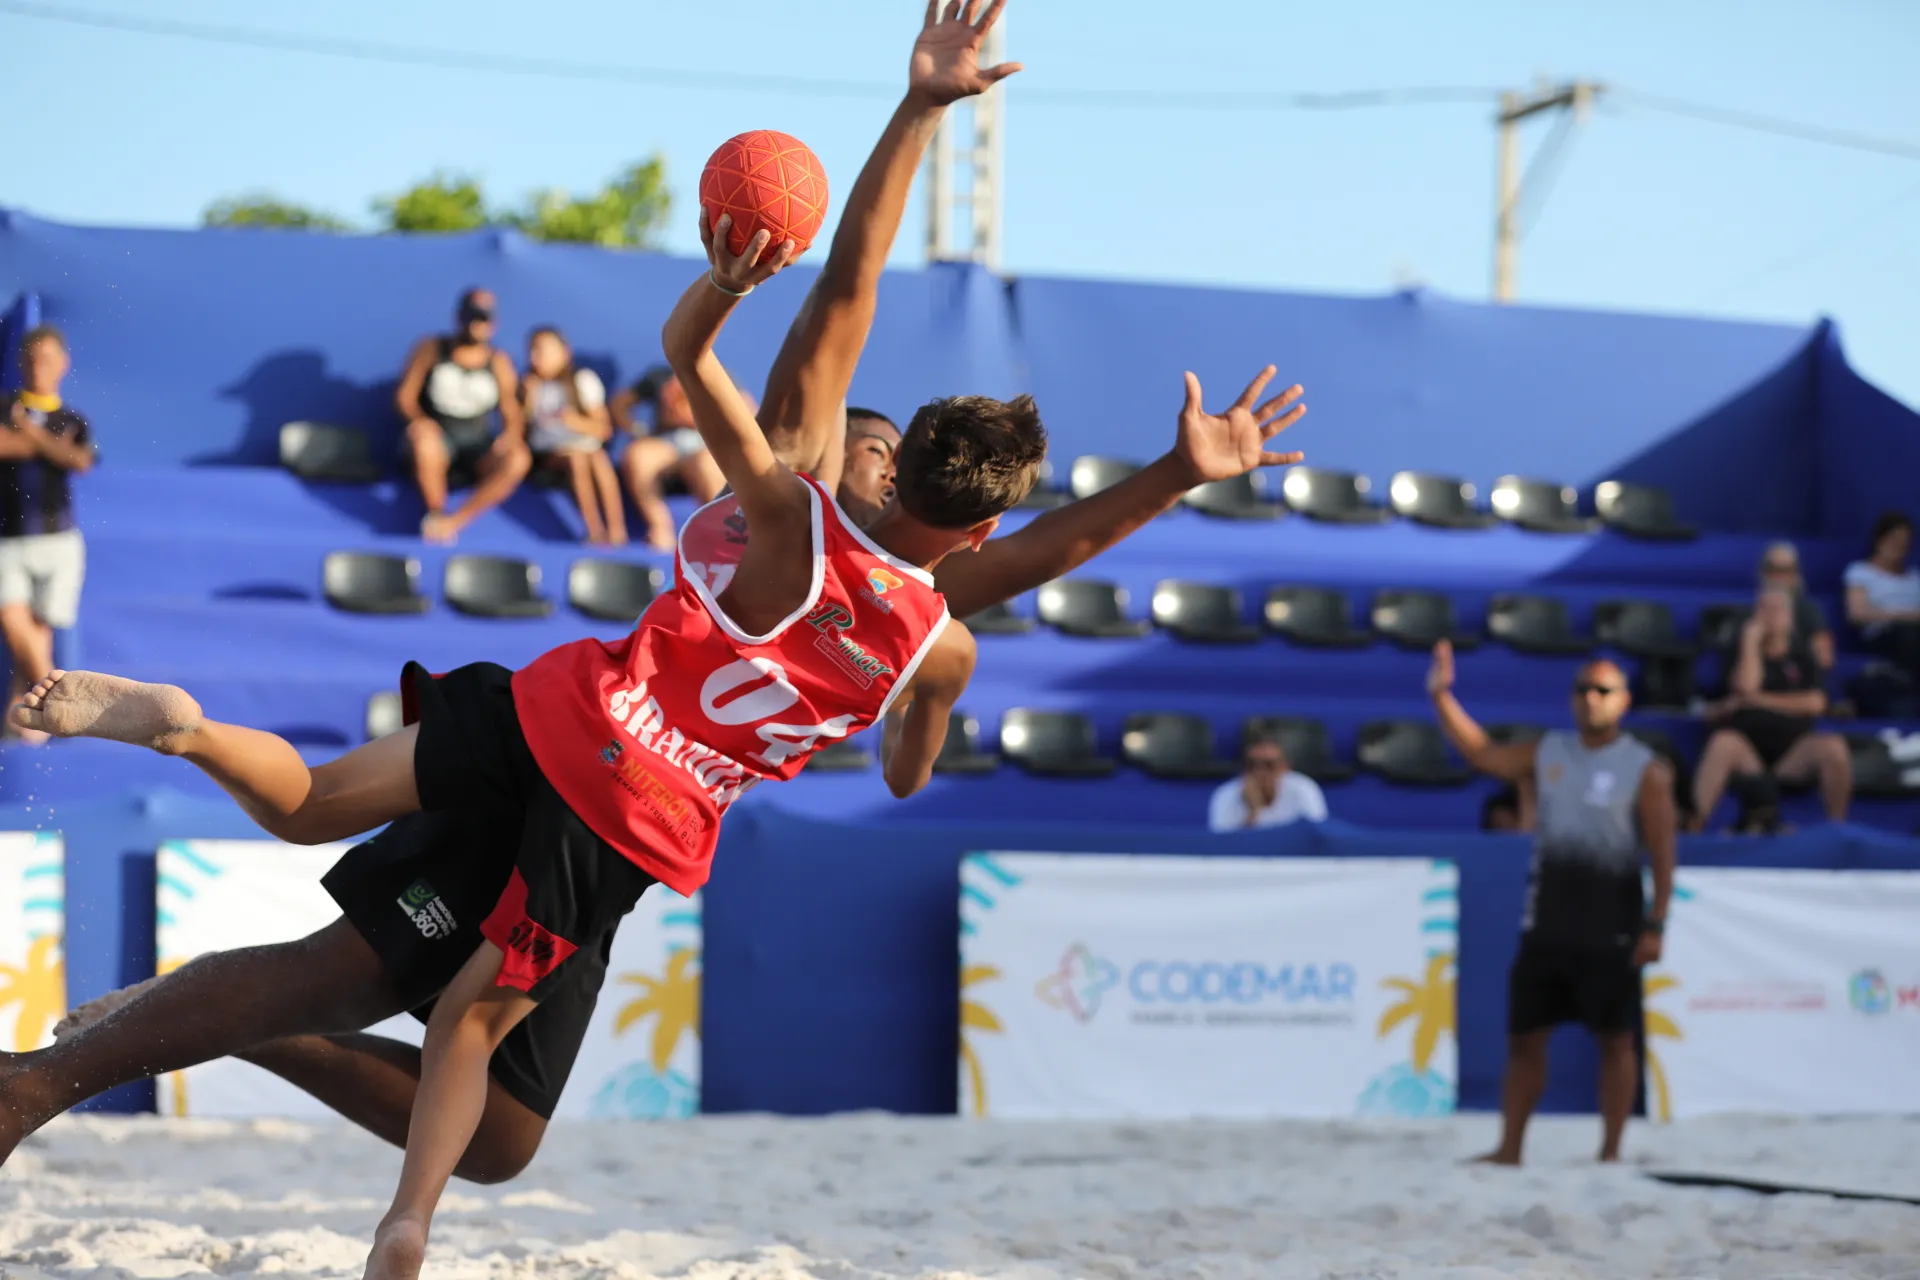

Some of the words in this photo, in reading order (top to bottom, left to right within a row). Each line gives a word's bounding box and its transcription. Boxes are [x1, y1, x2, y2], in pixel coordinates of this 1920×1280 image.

[805, 602, 893, 678] Pomar
[700, 657, 858, 768] 04
[611, 771, 643, 802] SEMPRE
[649, 806, 674, 832] FRENTE
[411, 909, 438, 938] 360
[1129, 960, 1357, 1003] CODEMAR
